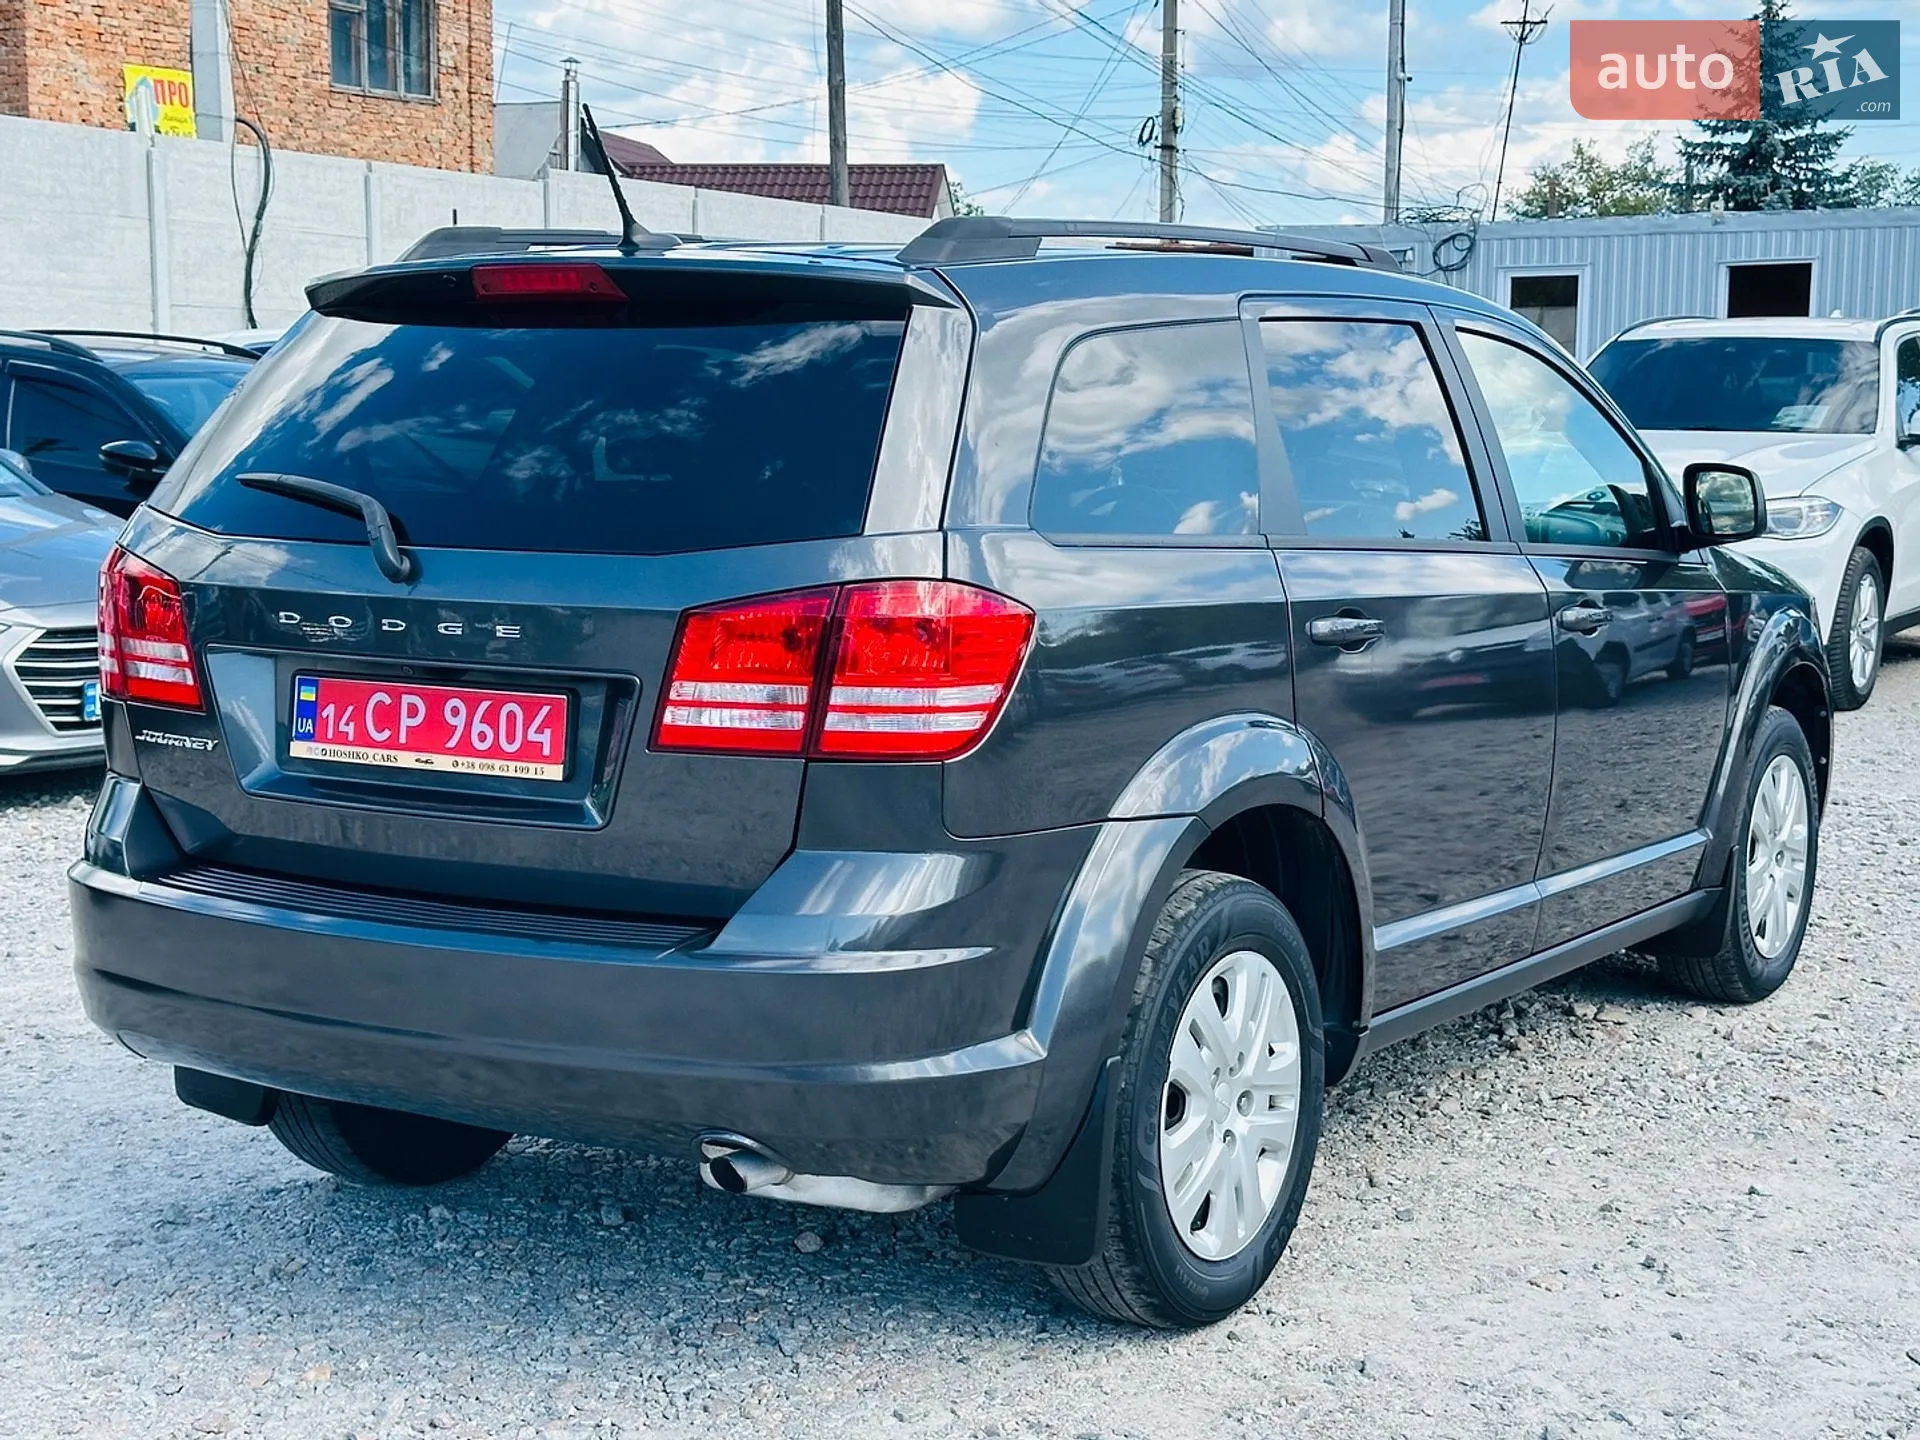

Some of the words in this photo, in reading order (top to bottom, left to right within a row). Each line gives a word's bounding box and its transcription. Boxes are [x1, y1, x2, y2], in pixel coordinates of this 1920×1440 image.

[278, 610, 521, 638] DODGE
[297, 717, 314, 734] UA
[321, 702, 355, 742] 14
[365, 691, 427, 744] CP
[443, 697, 552, 757] 9604
[135, 729, 219, 751] JOURNEY
